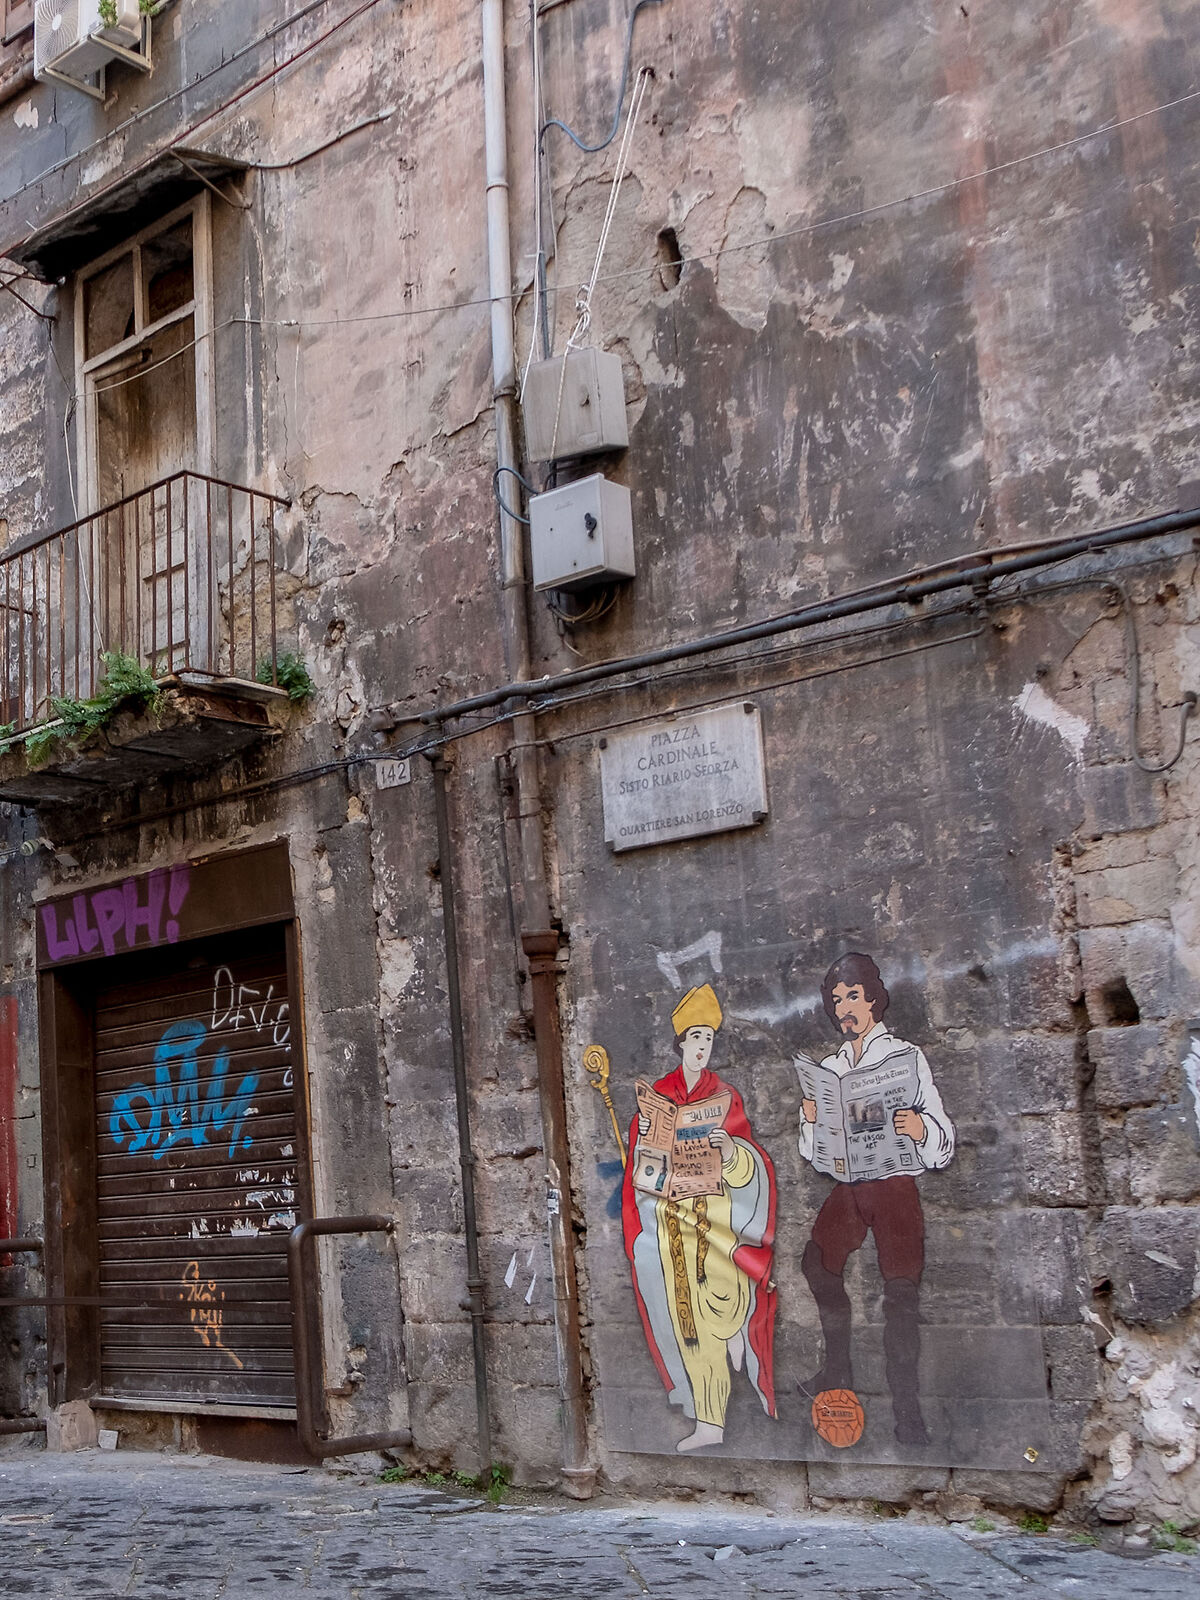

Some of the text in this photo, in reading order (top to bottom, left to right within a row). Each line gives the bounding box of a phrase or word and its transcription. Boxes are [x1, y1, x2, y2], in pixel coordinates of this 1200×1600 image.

[651, 725, 700, 747] PIAZZA
[637, 741, 717, 770] CARDINALE
[381, 762, 406, 784] 142
[619, 759, 739, 795] SISTO RIARIO SFORZA
[619, 804, 743, 837] QUARTIERE SAN LORENZO
[851, 1069, 909, 1089] The New York Times
[848, 1136, 860, 1144] THE
[865, 1141, 878, 1149] ART
